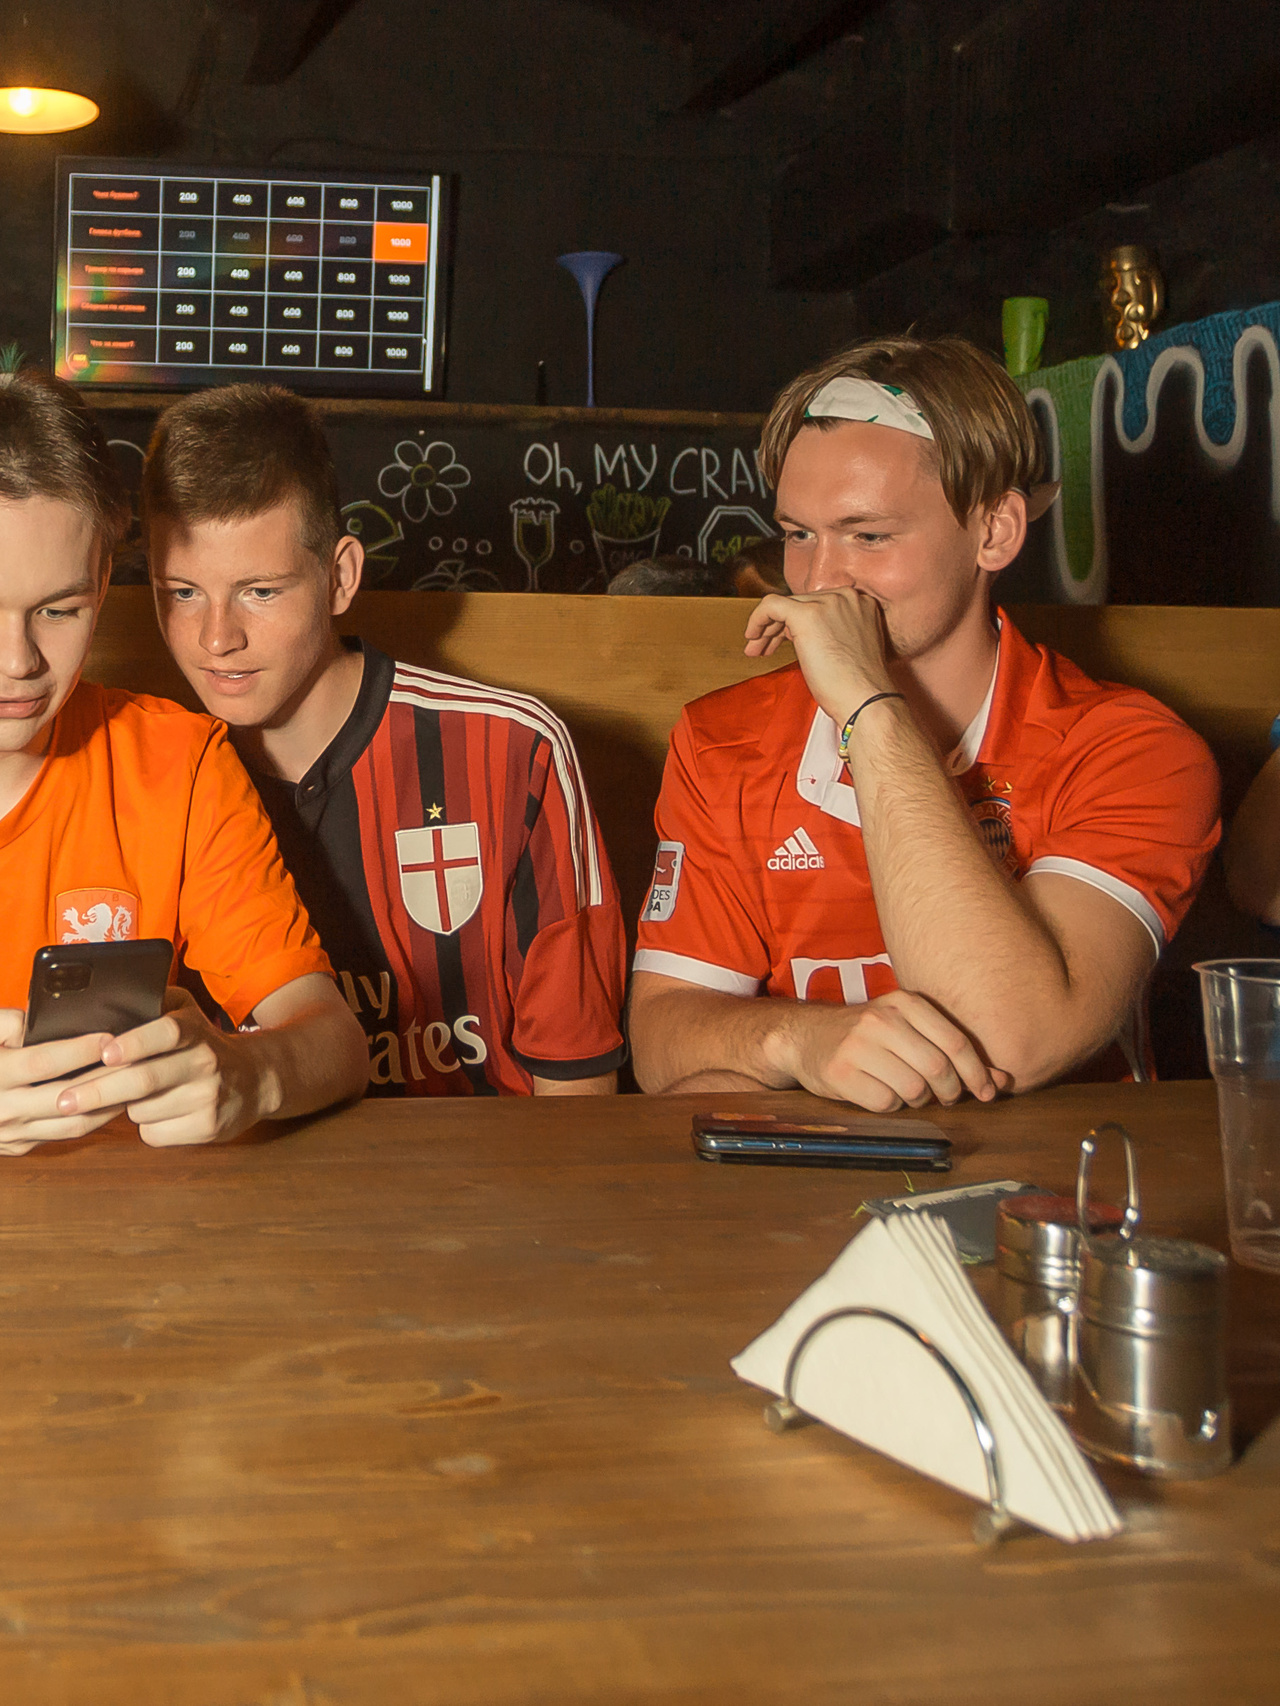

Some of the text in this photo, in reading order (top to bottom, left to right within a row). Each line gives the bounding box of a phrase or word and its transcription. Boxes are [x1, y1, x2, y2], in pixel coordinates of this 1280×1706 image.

[179, 192, 197, 202] 200
[233, 195, 252, 205] 400
[287, 197, 305, 207] 600
[340, 199, 358, 208] 800
[391, 201, 413, 210] 1000
[179, 230, 195, 239] 200
[286, 234, 303, 242] 600
[339, 236, 356, 244] 800
[391, 239, 411, 247] 1000
[178, 267, 195, 277] 200
[231, 269, 249, 278] 400
[284, 271, 302, 280] 600
[337, 273, 355, 283] 800
[389, 275, 410, 285] 1000
[176, 304, 194, 314] 200
[230, 306, 248, 316] 400
[283, 308, 301, 318] 600
[336, 310, 354, 318] 800
[388, 312, 408, 320] 1000
[176, 342, 193, 351] 200
[229, 343, 247, 353] 400
[282, 345, 300, 354] 600
[335, 346, 353, 356] 800
[386, 348, 407, 358] 1000
[523, 441, 583, 496] Oh,
[594, 442, 658, 492] MY
[766, 853, 825, 871] adidas
